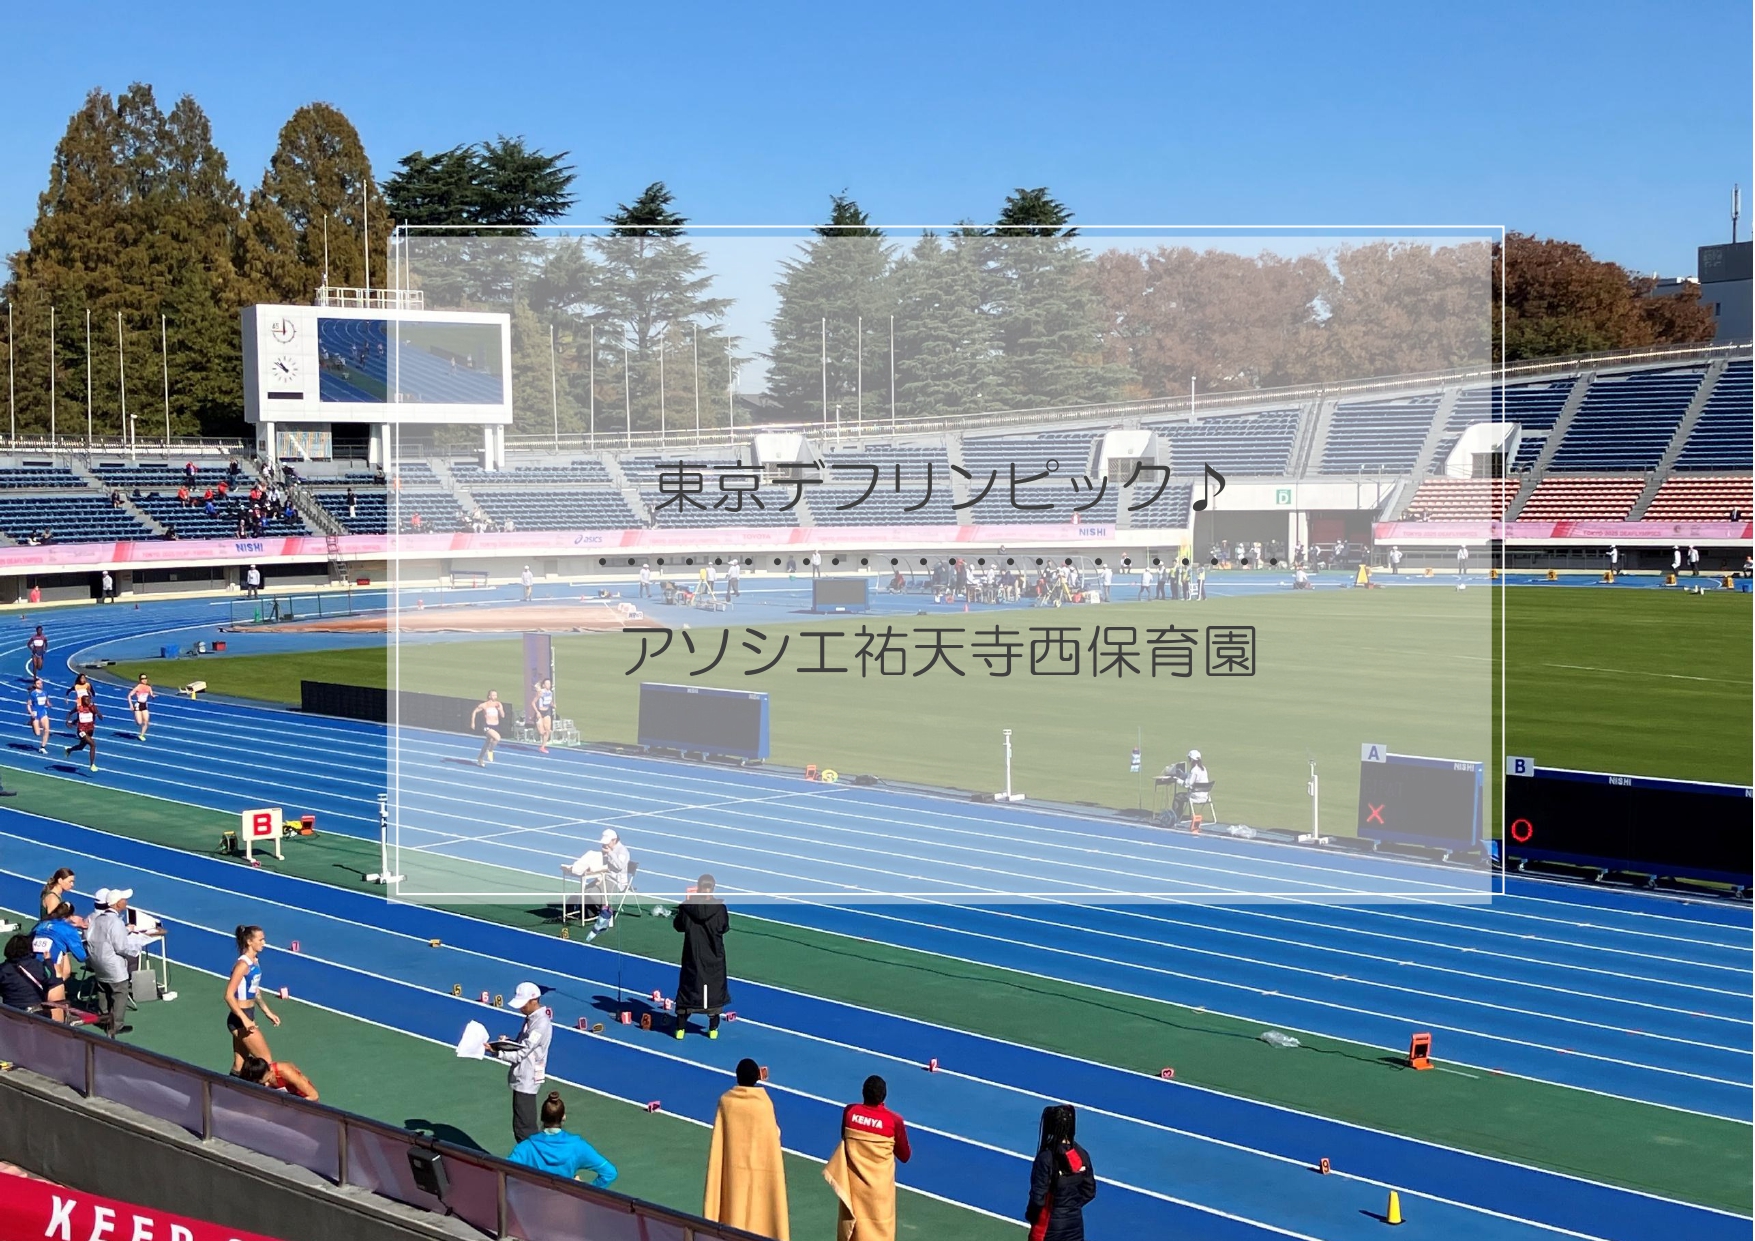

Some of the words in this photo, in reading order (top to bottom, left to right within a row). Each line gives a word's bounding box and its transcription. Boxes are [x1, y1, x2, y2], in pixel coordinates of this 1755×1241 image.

[1078, 527, 1106, 537] NISHI
[235, 543, 264, 552] NISHI
[1367, 745, 1380, 761] A
[1453, 762, 1475, 772] NISHI
[1514, 758, 1526, 774] B
[1608, 776, 1632, 786] NISHI
[253, 813, 272, 836] B
[851, 1113, 883, 1129] KENYA
